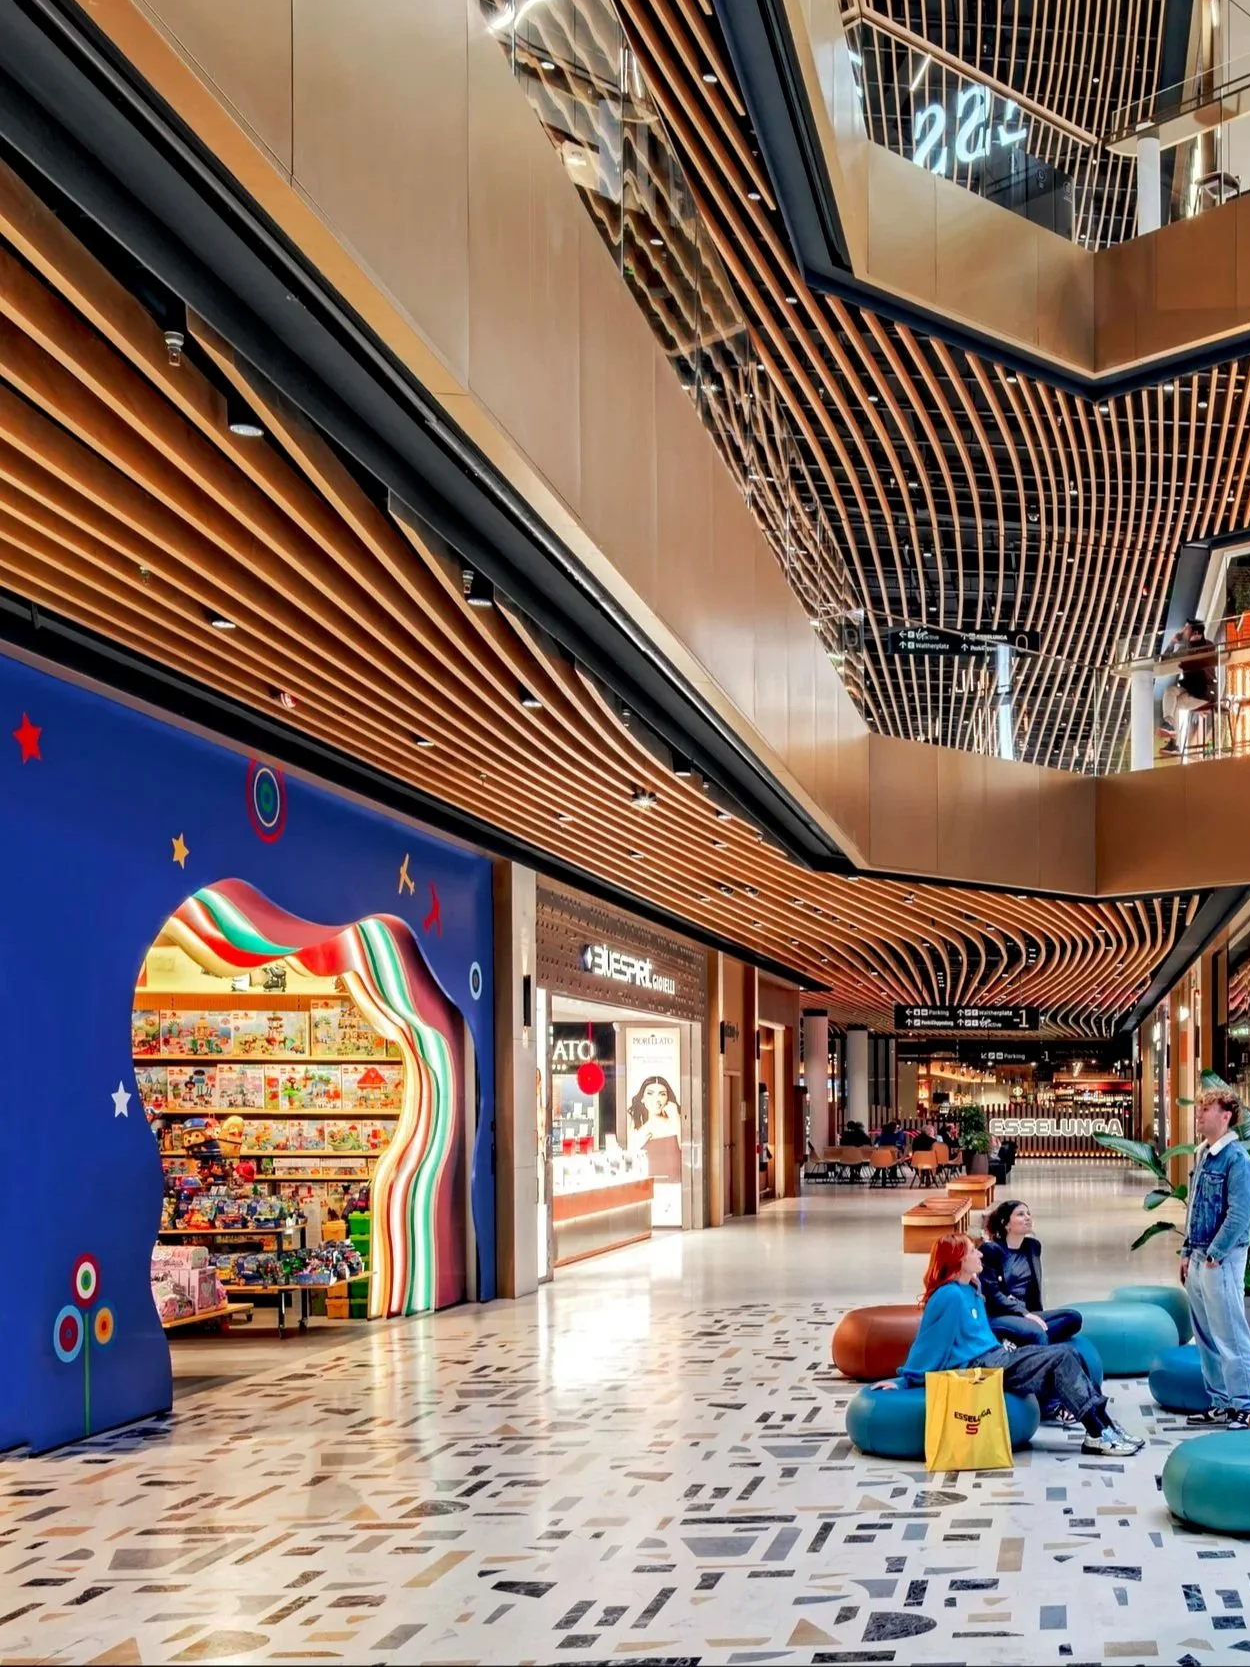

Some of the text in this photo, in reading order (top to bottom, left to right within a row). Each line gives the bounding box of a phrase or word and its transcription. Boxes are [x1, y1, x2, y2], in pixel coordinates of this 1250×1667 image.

[929, 1009, 950, 1017] Parking
[1013, 1009, 1029, 1028] -1
[1004, 1052, 1026, 1060] Parking
[990, 1118, 1124, 1137] ESSELUNGA
